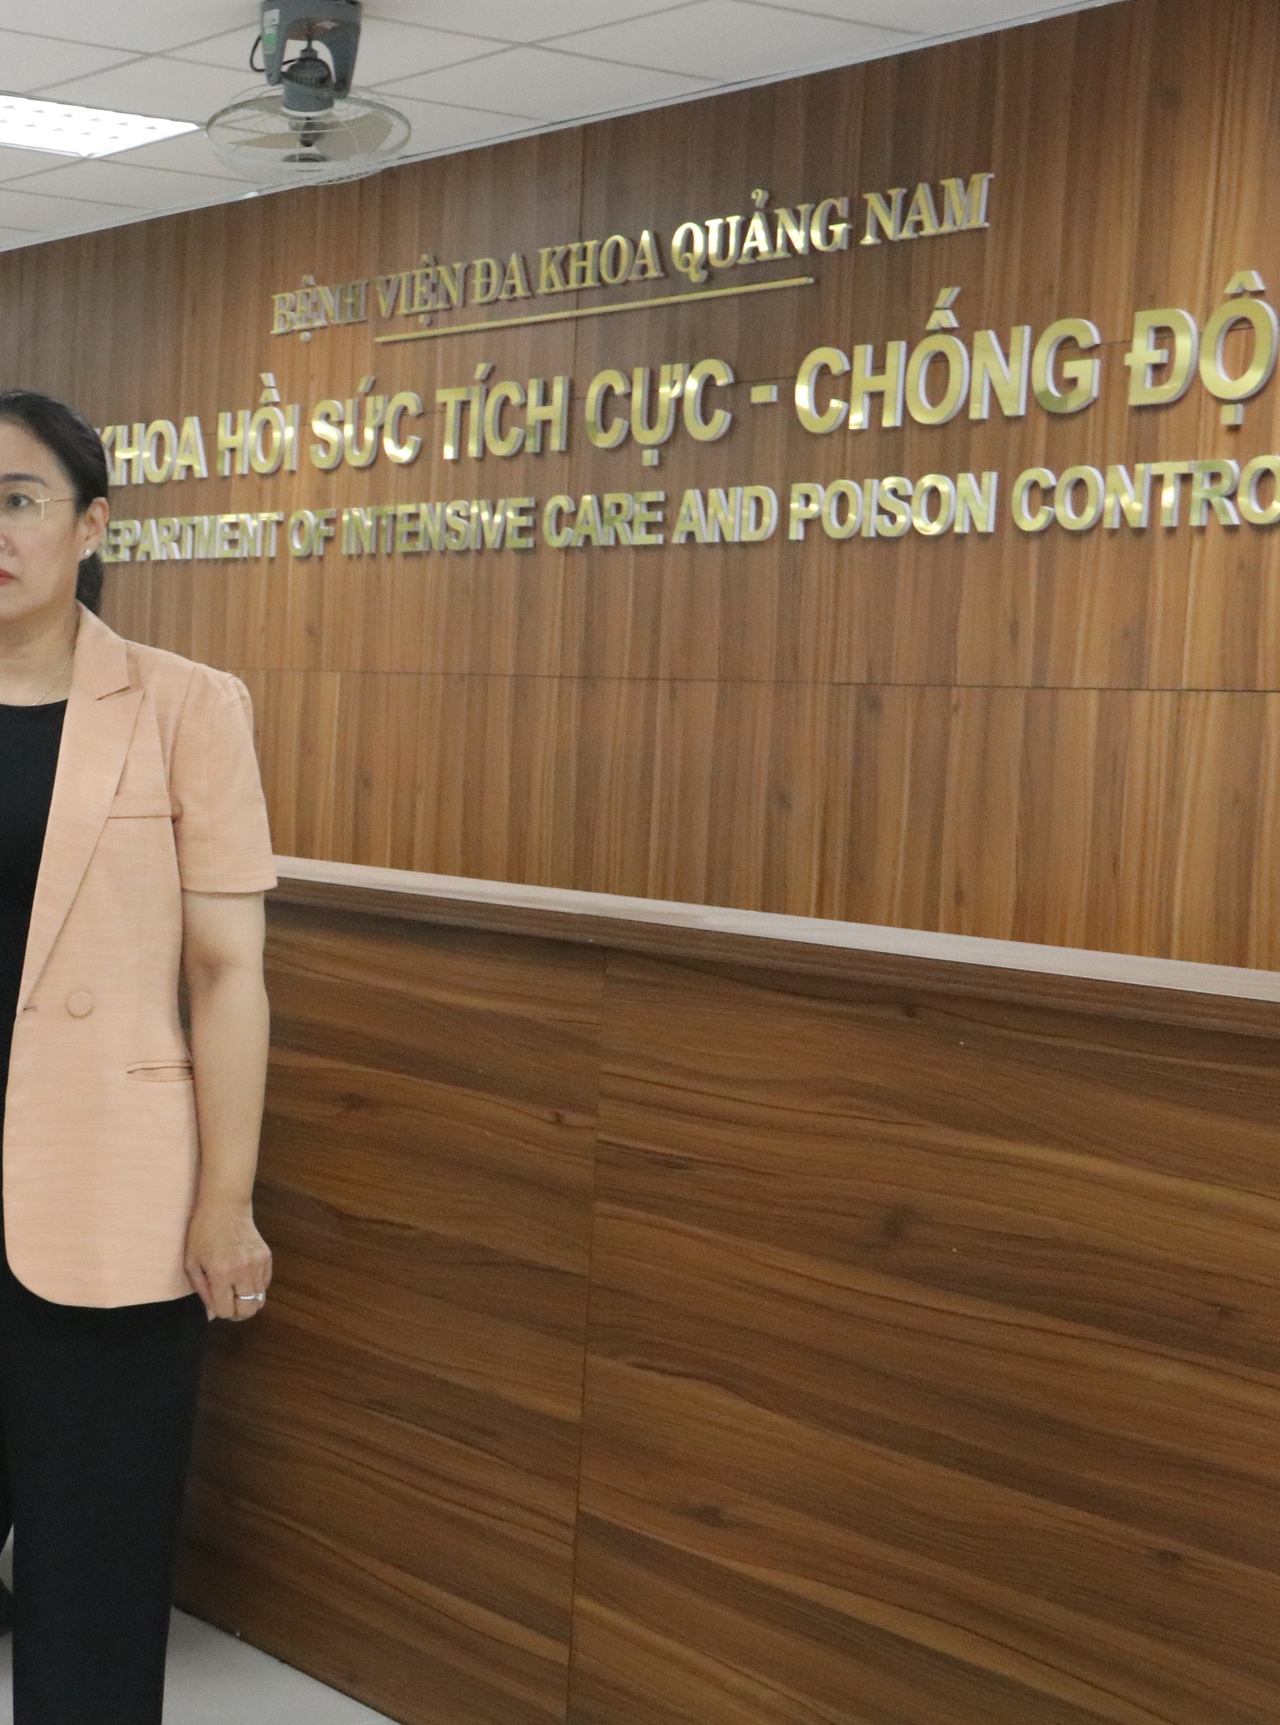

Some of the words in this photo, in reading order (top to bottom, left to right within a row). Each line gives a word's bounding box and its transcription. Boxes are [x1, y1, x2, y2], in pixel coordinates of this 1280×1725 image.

[271, 275, 368, 342] BỆNH
[376, 255, 469, 326] VIỆN
[471, 253, 531, 304] ĐA
[537, 229, 664, 295] KHOA
[671, 189, 852, 283] QUẢNG
[859, 172, 995, 245] NAM
[217, 372, 300, 477] HỒI
[310, 376, 422, 470] SỨC
[436, 362, 569, 460] TÍCH
[585, 358, 734, 466] CỰC
[751, 384, 778, 404] -
[795, 287, 1102, 434] CHỐNG
[101, 512, 285, 563] EPARTMENT
[287, 508, 337, 557] OF
[341, 498, 536, 555] INTENSIVE
[542, 490, 665, 548] CARE
[672, 485, 778, 544] AND
[789, 471, 998, 541] POISON
